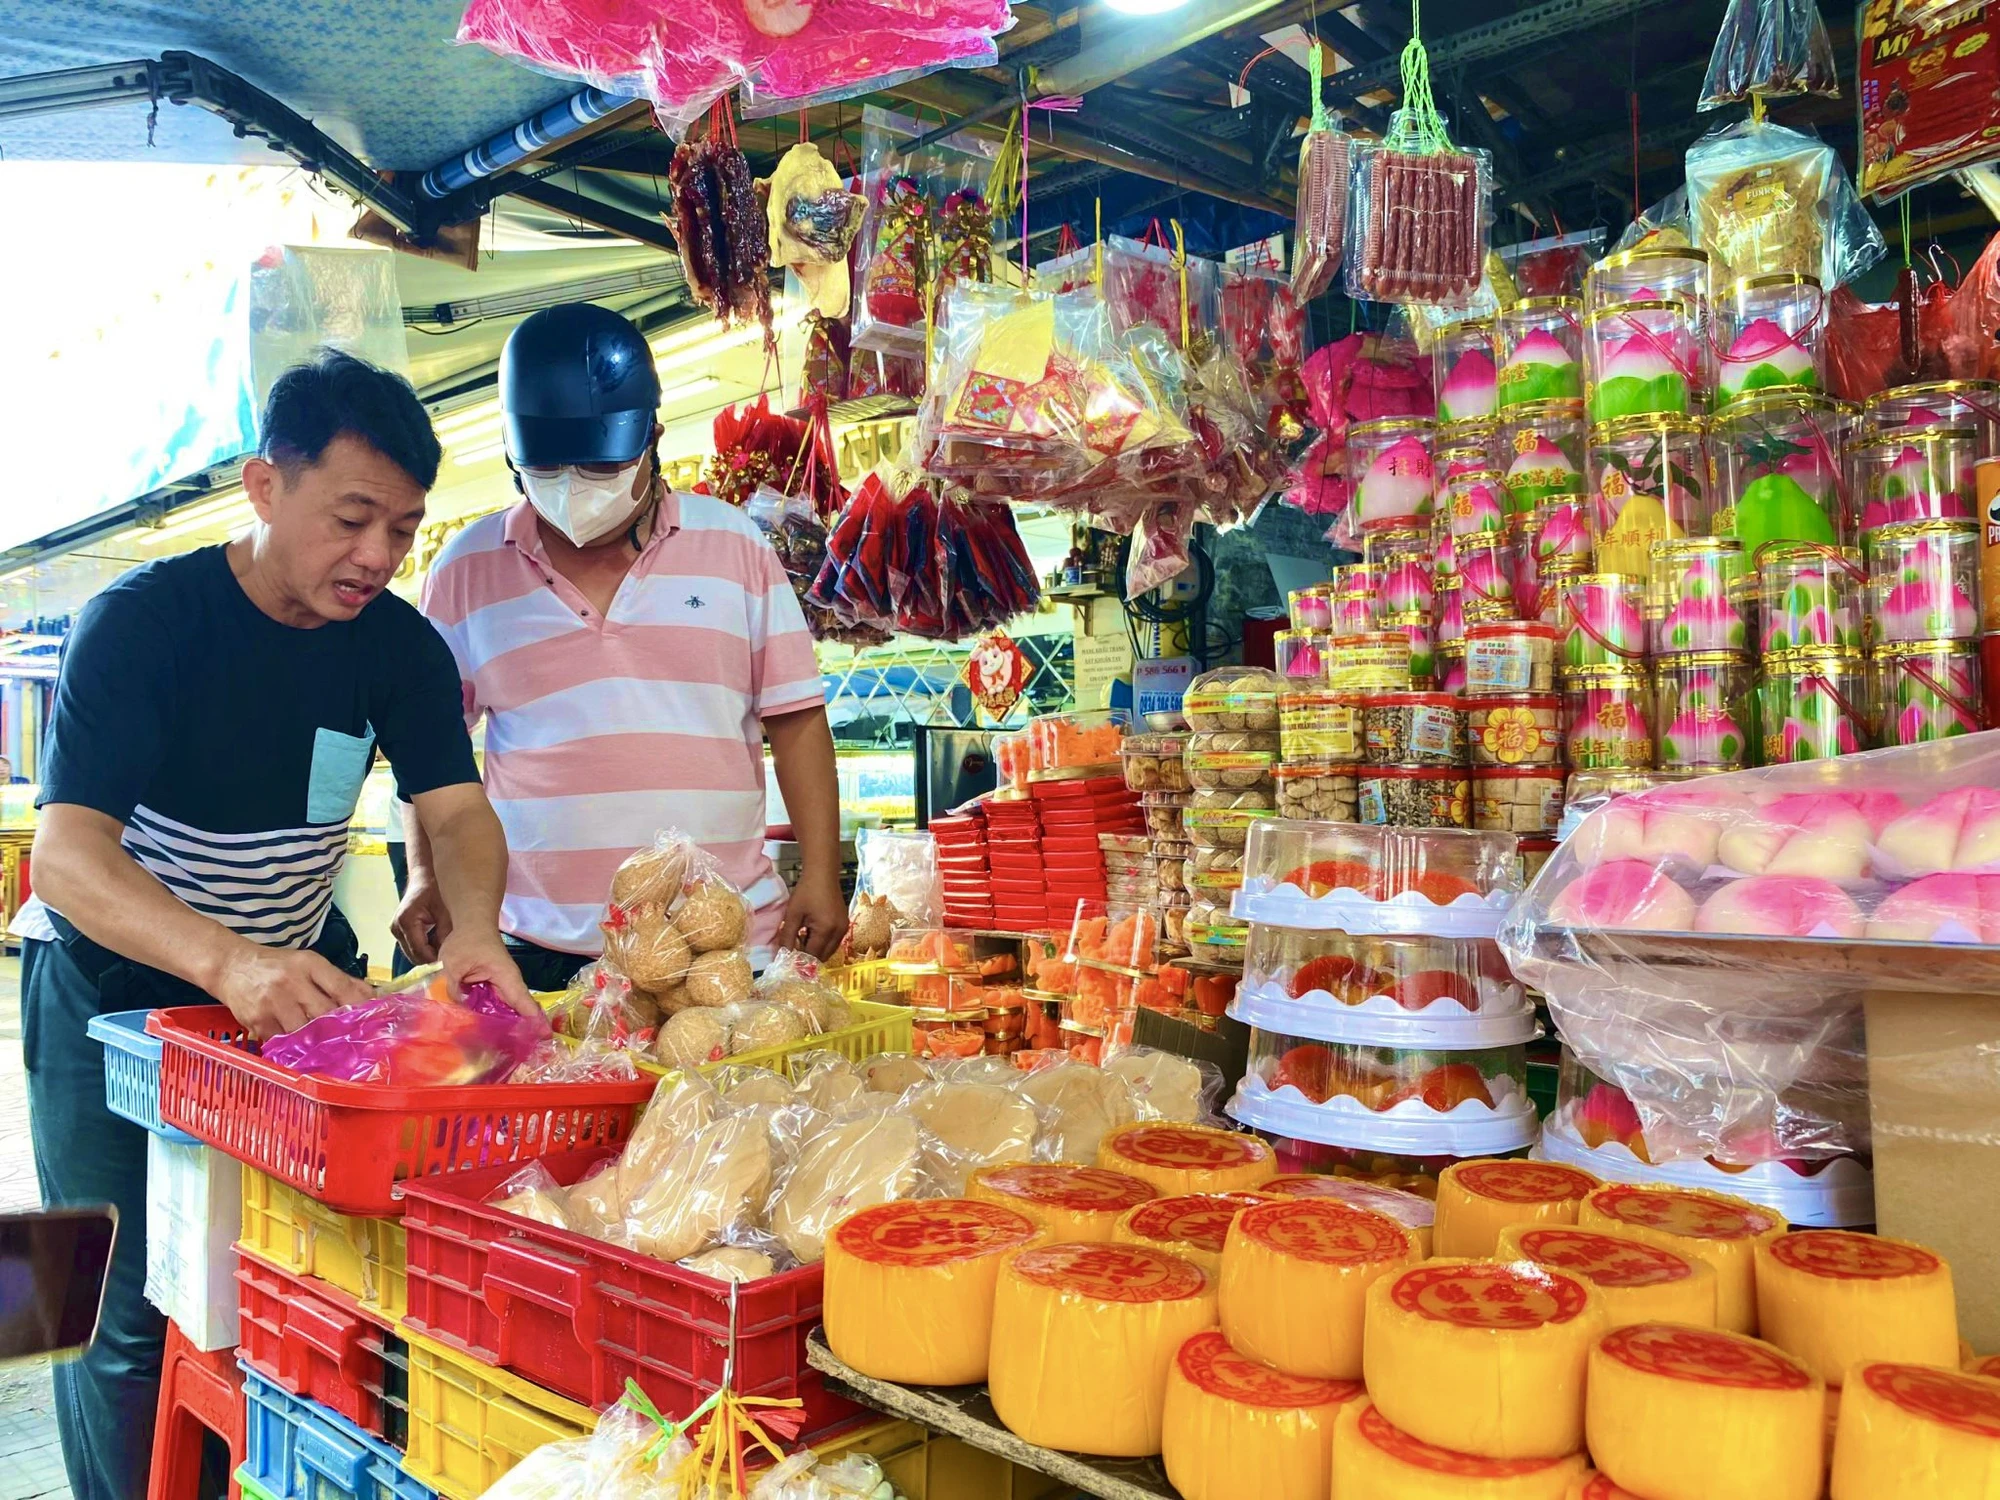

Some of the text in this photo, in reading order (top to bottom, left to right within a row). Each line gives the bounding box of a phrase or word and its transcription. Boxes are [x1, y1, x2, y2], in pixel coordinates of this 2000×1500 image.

[1513, 428, 1538, 454] 福
[1602, 471, 1626, 498] 福
[1453, 492, 1474, 517] 福
[1597, 702, 1627, 730] 福
[1498, 722, 1523, 748] 福
[1060, 1250, 1166, 1284] 福
